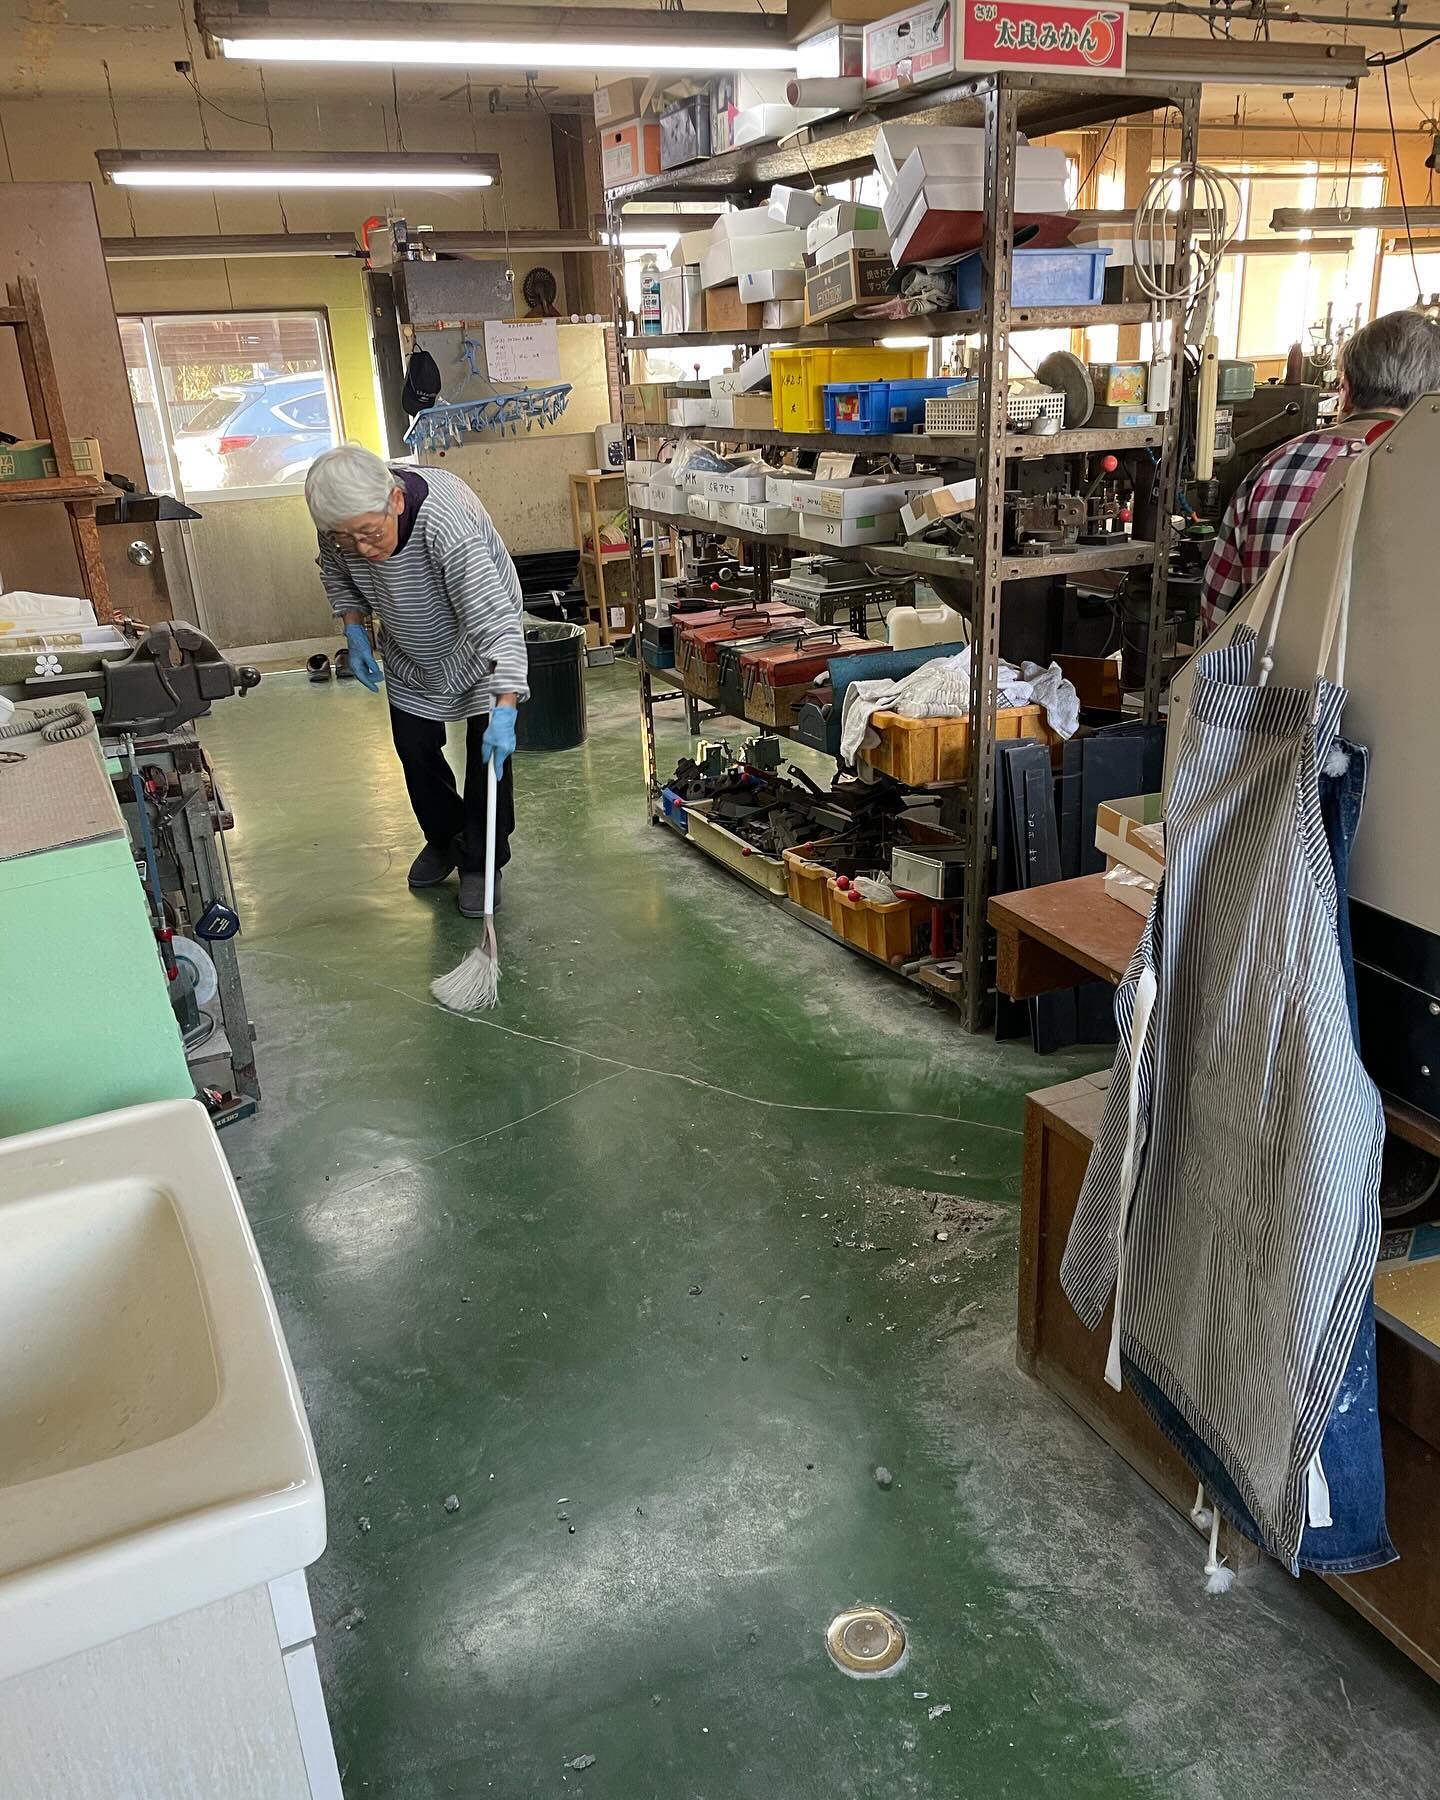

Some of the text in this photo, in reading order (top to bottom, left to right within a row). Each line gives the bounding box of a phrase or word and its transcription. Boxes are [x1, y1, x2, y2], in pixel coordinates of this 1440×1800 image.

[974, 4, 997, 21] さが
[994, 18, 1098, 53] 太良みかん
[0, 455, 12, 465] YA
[0, 465, 14, 474] ER
